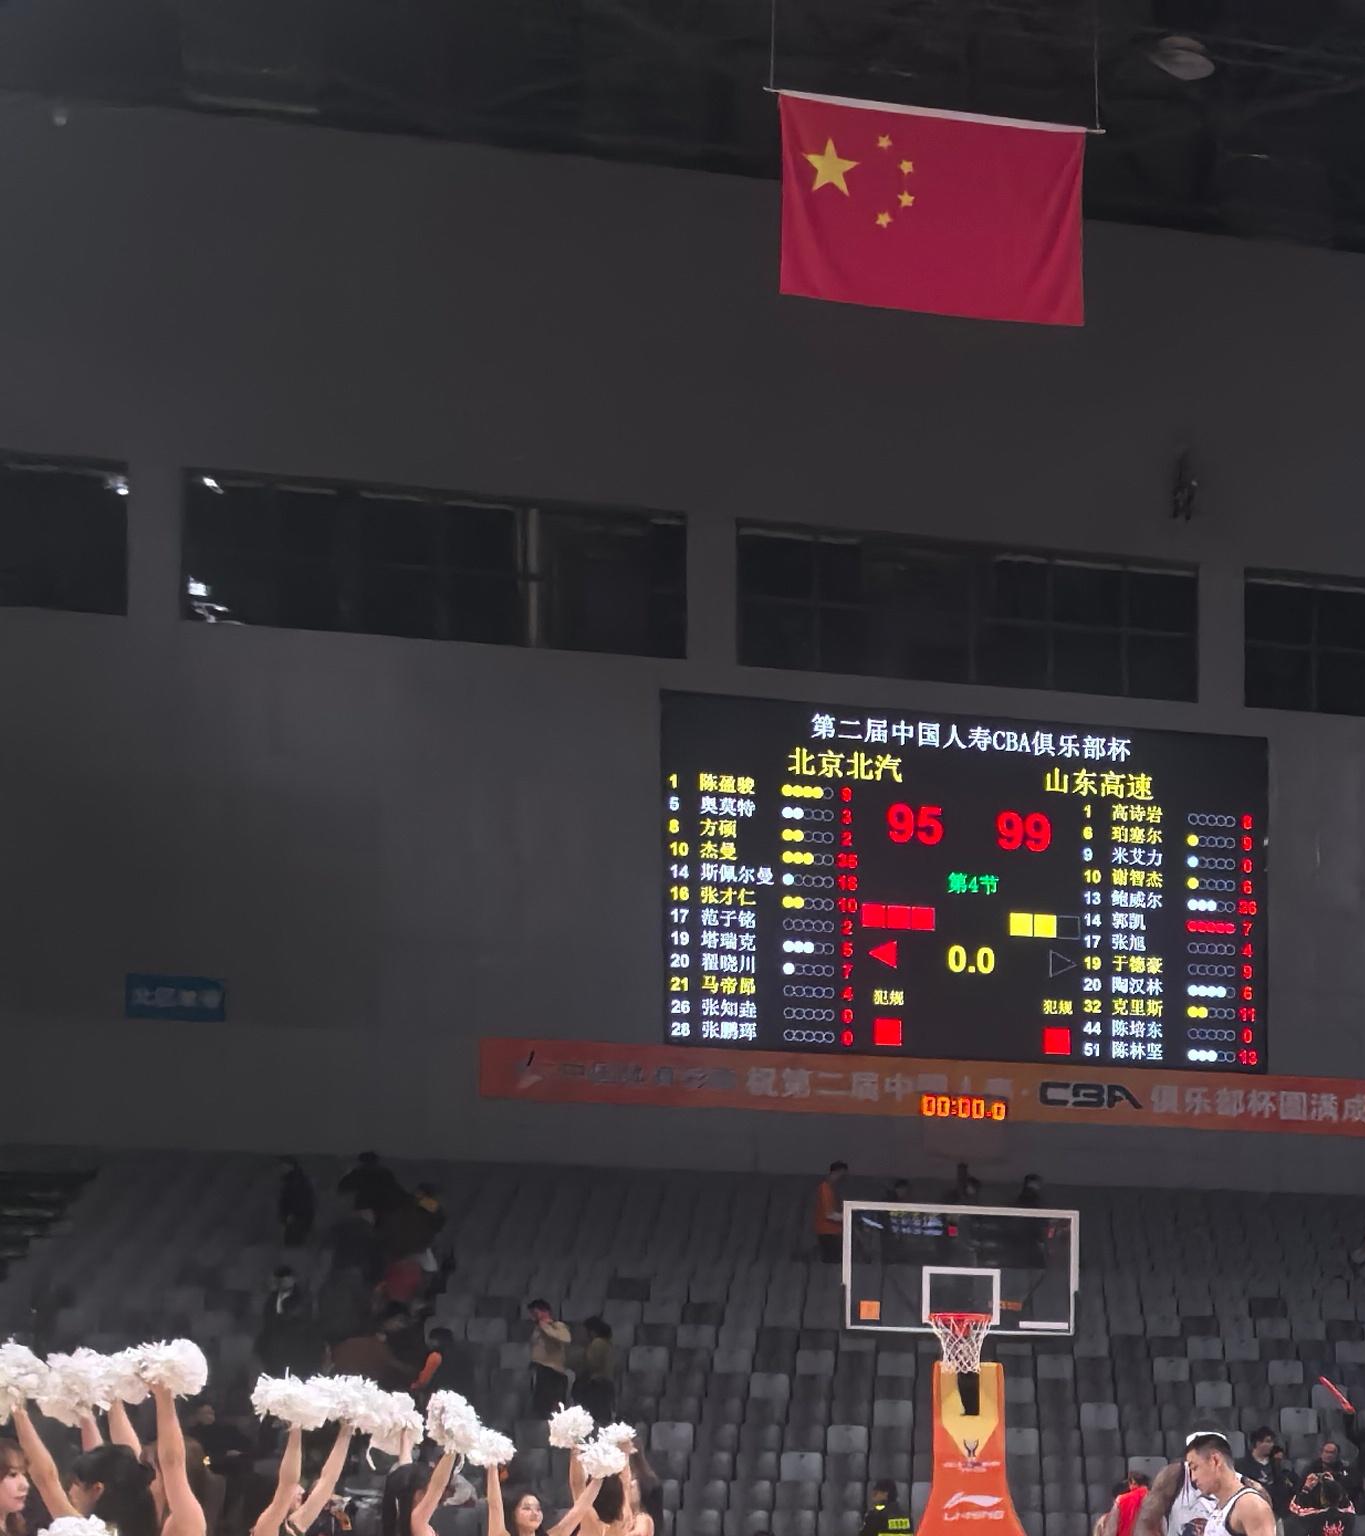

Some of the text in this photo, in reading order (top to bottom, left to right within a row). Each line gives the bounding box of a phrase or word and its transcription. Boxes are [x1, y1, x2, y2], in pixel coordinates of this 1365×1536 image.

[811, 713, 1132, 763] 第二届中国人寿CBA俱乐部杯
[788, 748, 903, 783] 北京北汽
[670, 774, 677, 788] 1
[700, 773, 755, 794] 陈盈骏
[1045, 767, 1154, 801] 山东高速
[669, 796, 679, 811] 5
[700, 793, 755, 817] 奥莫特
[1084, 805, 1091, 818] 1
[1112, 804, 1163, 823] 高诗岩
[669, 818, 852, 846] 8 方硕 2
[888, 804, 943, 844] 95
[997, 812, 1051, 851] 99
[1083, 827, 1093, 839] 6
[670, 842, 689, 856] 10
[700, 840, 737, 860] 杰曼
[1083, 847, 1252, 873] 9 米艾力 0
[670, 864, 689, 879] 14
[700, 863, 774, 885] 斯佩尔曼
[948, 872, 999, 895] 第4节
[1084, 868, 1252, 894] 10 谢智杰 6
[670, 886, 858, 914] 16 张才仁 10
[1084, 891, 1101, 905] 13
[1111, 890, 1162, 909] 鲍威尔
[670, 907, 853, 936] 17 范子铭 2
[1084, 911, 1252, 936] 14 郭凯 7
[671, 930, 689, 945] 19
[1084, 933, 1252, 957] 17 张旭 4
[670, 952, 853, 978] 20 翟晓川 7
[948, 945, 994, 973] 0.0
[1084, 955, 1252, 979] 19 于德豪 9
[671, 976, 688, 991] 21
[843, 987, 853, 1001] 4
[874, 990, 904, 1005] 犯规
[1083, 976, 1252, 1000] 20 陶汉林 6
[671, 999, 690, 1014] 26
[1044, 1000, 1073, 1015] 犯规
[1084, 998, 1255, 1021] 32 克里斯 11
[671, 1021, 690, 1037] 28
[1083, 1019, 1252, 1043] 44 陈培东 0
[1083, 1040, 1257, 1065] 51 陈林坚 13
[921, 1095, 1006, 1121] 00:00.0
